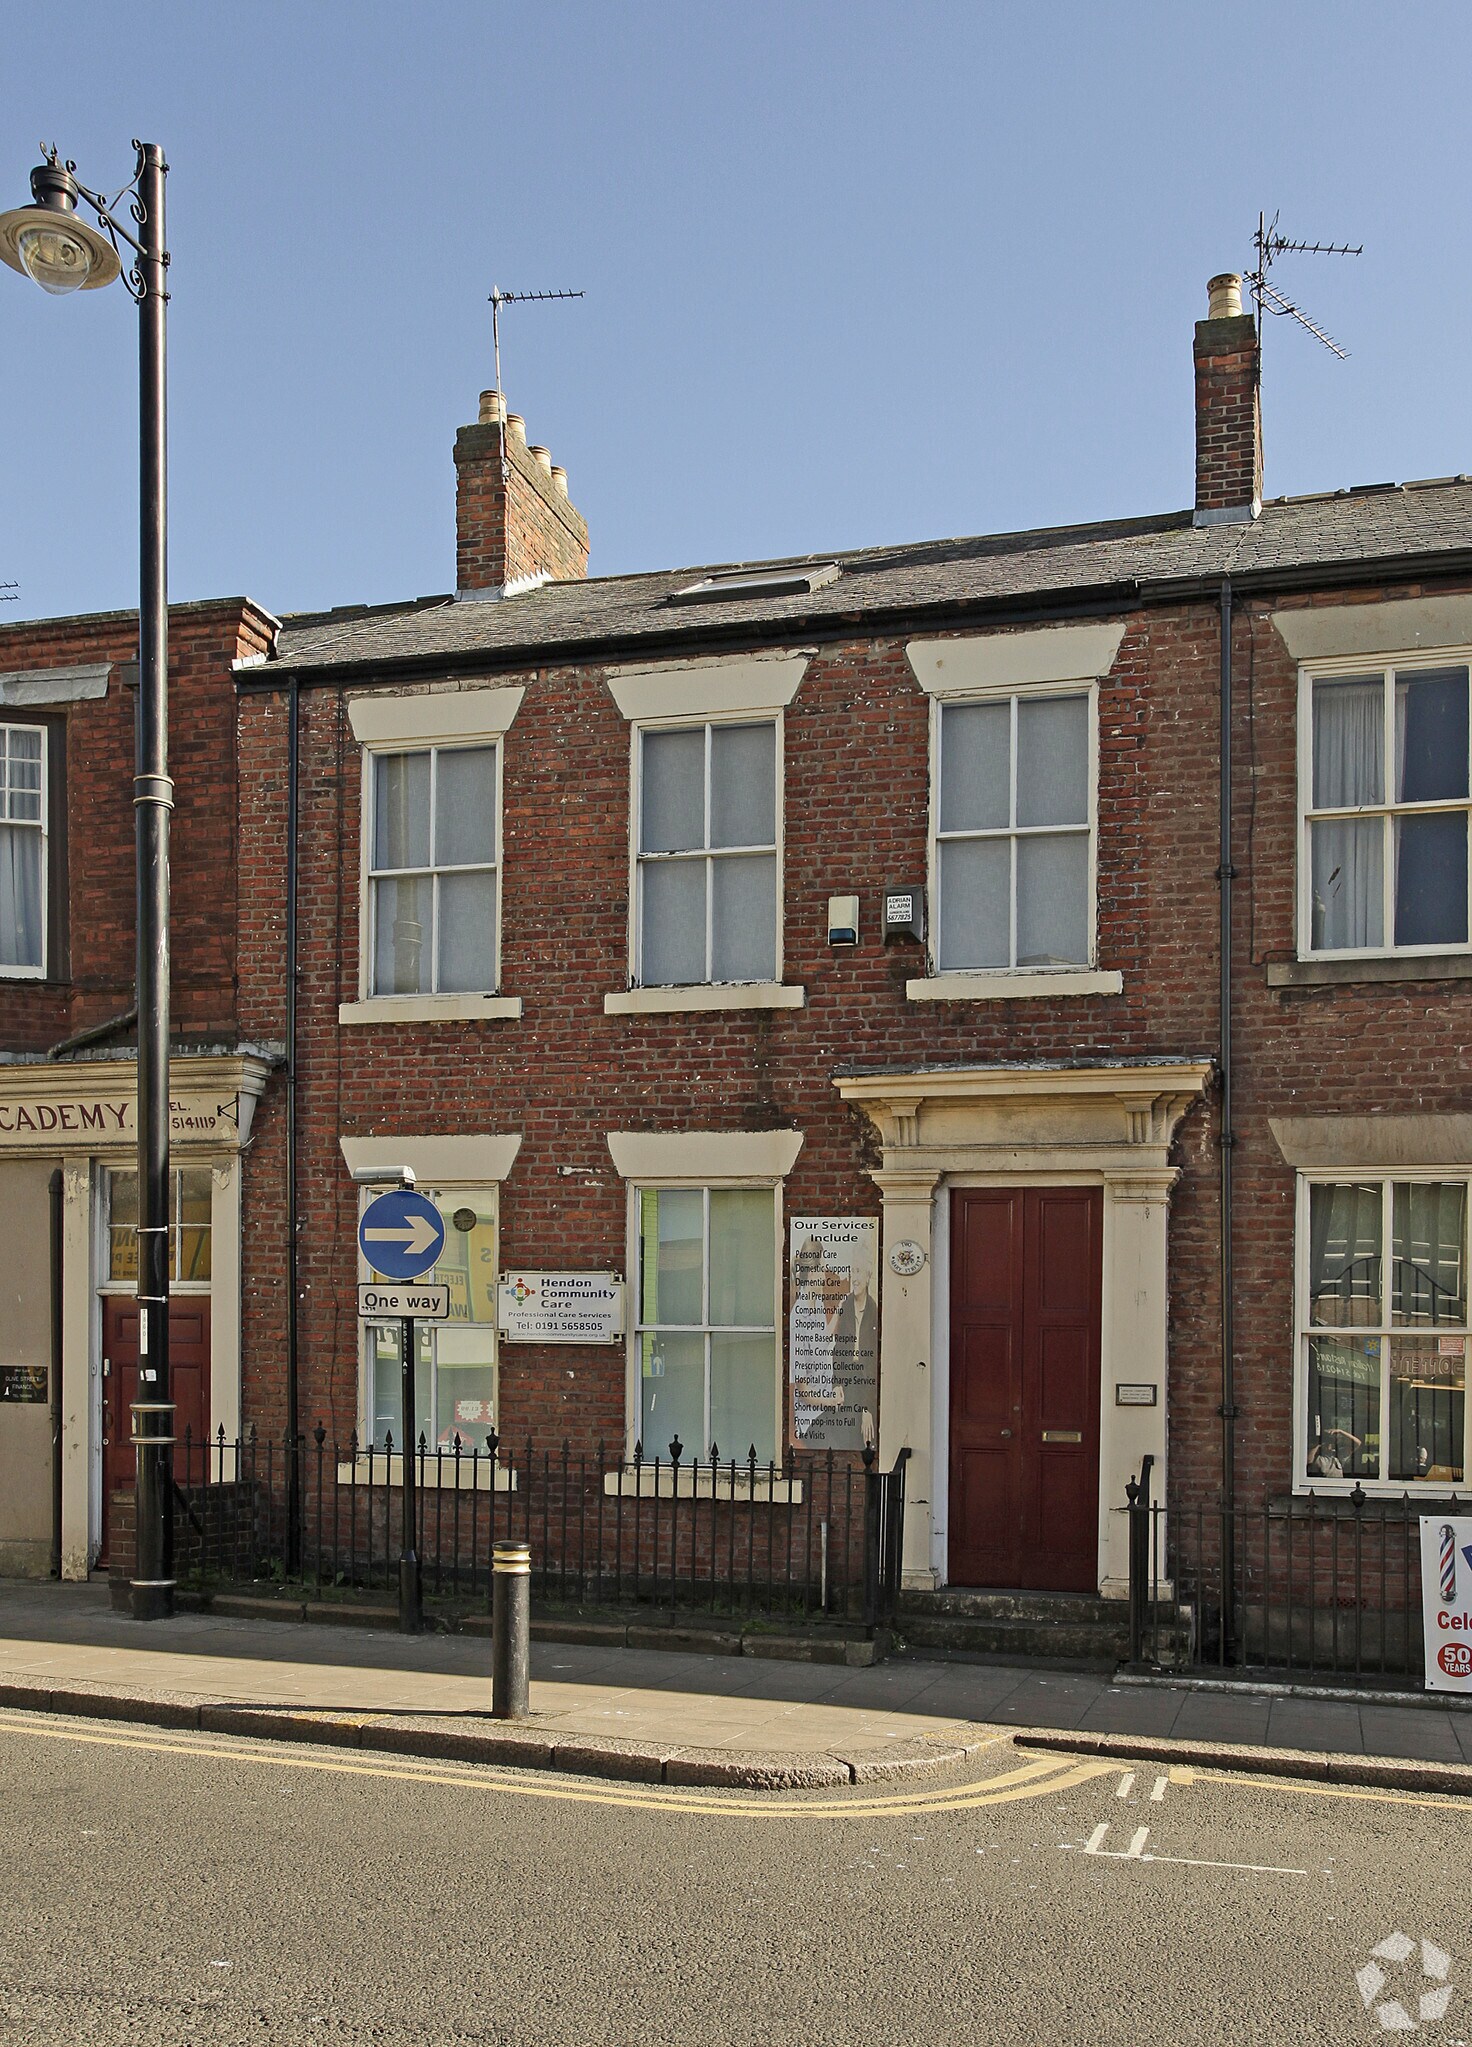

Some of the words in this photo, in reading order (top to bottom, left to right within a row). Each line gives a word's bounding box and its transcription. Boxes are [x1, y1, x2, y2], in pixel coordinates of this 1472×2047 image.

[169, 1101, 191, 1112] EL.
[172, 1116, 216, 1129] 5141119
[794, 1220, 819, 1230] Our
[821, 1220, 875, 1230] Services
[810, 1233, 859, 1243] Include
[795, 1249, 821, 1259] Personal
[822, 1249, 837, 1259] Care
[795, 1263, 824, 1275] Domestic
[825, 1264, 851, 1275] Support
[541, 1278, 592, 1287] Hendon
[795, 1277, 825, 1287] Dementia
[826, 1277, 841, 1287] Care
[541, 1289, 616, 1299] Community
[795, 1291, 811, 1300] Meal
[811, 1291, 848, 1302] Preparation
[364, 1292, 399, 1308] One
[406, 1298, 440, 1312] way
[541, 1300, 573, 1308] Care
[794, 1305, 844, 1317] Companionship
[516, 1322, 533, 1330] Tel:
[535, 1322, 559, 1330] 0191
[561, 1322, 603, 1331] 5658505
[794, 1319, 825, 1331] Shopping
[794, 1333, 814, 1342] Home
[814, 1334, 833, 1343] Based
[834, 1334, 858, 1345] Respite
[794, 1347, 814, 1356] Home
[814, 1347, 860, 1357] Convalescence
[794, 1361, 832, 1372] Prescription
[832, 1361, 864, 1371] Collection
[794, 1374, 820, 1386] Hospital
[821, 1375, 853, 1388] Discharge
[853, 1375, 876, 1386] Service
[794, 1389, 821, 1399] Escorted
[822, 1389, 837, 1399] Care
[794, 1402, 811, 1412] Short
[820, 1402, 836, 1414] Long
[836, 1404, 853, 1412] Term
[853, 1404, 868, 1413] Care
[794, 1416, 811, 1426] From
[811, 1417, 835, 1427] pop-ins
[836, 1418, 843, 1426] to
[843, 1418, 856, 1427] Full
[794, 1430, 807, 1440] Care
[808, 1430, 825, 1440] Visits
[1444, 1647, 1471, 1663] 50
[1444, 1663, 1471, 1673] YEARS
